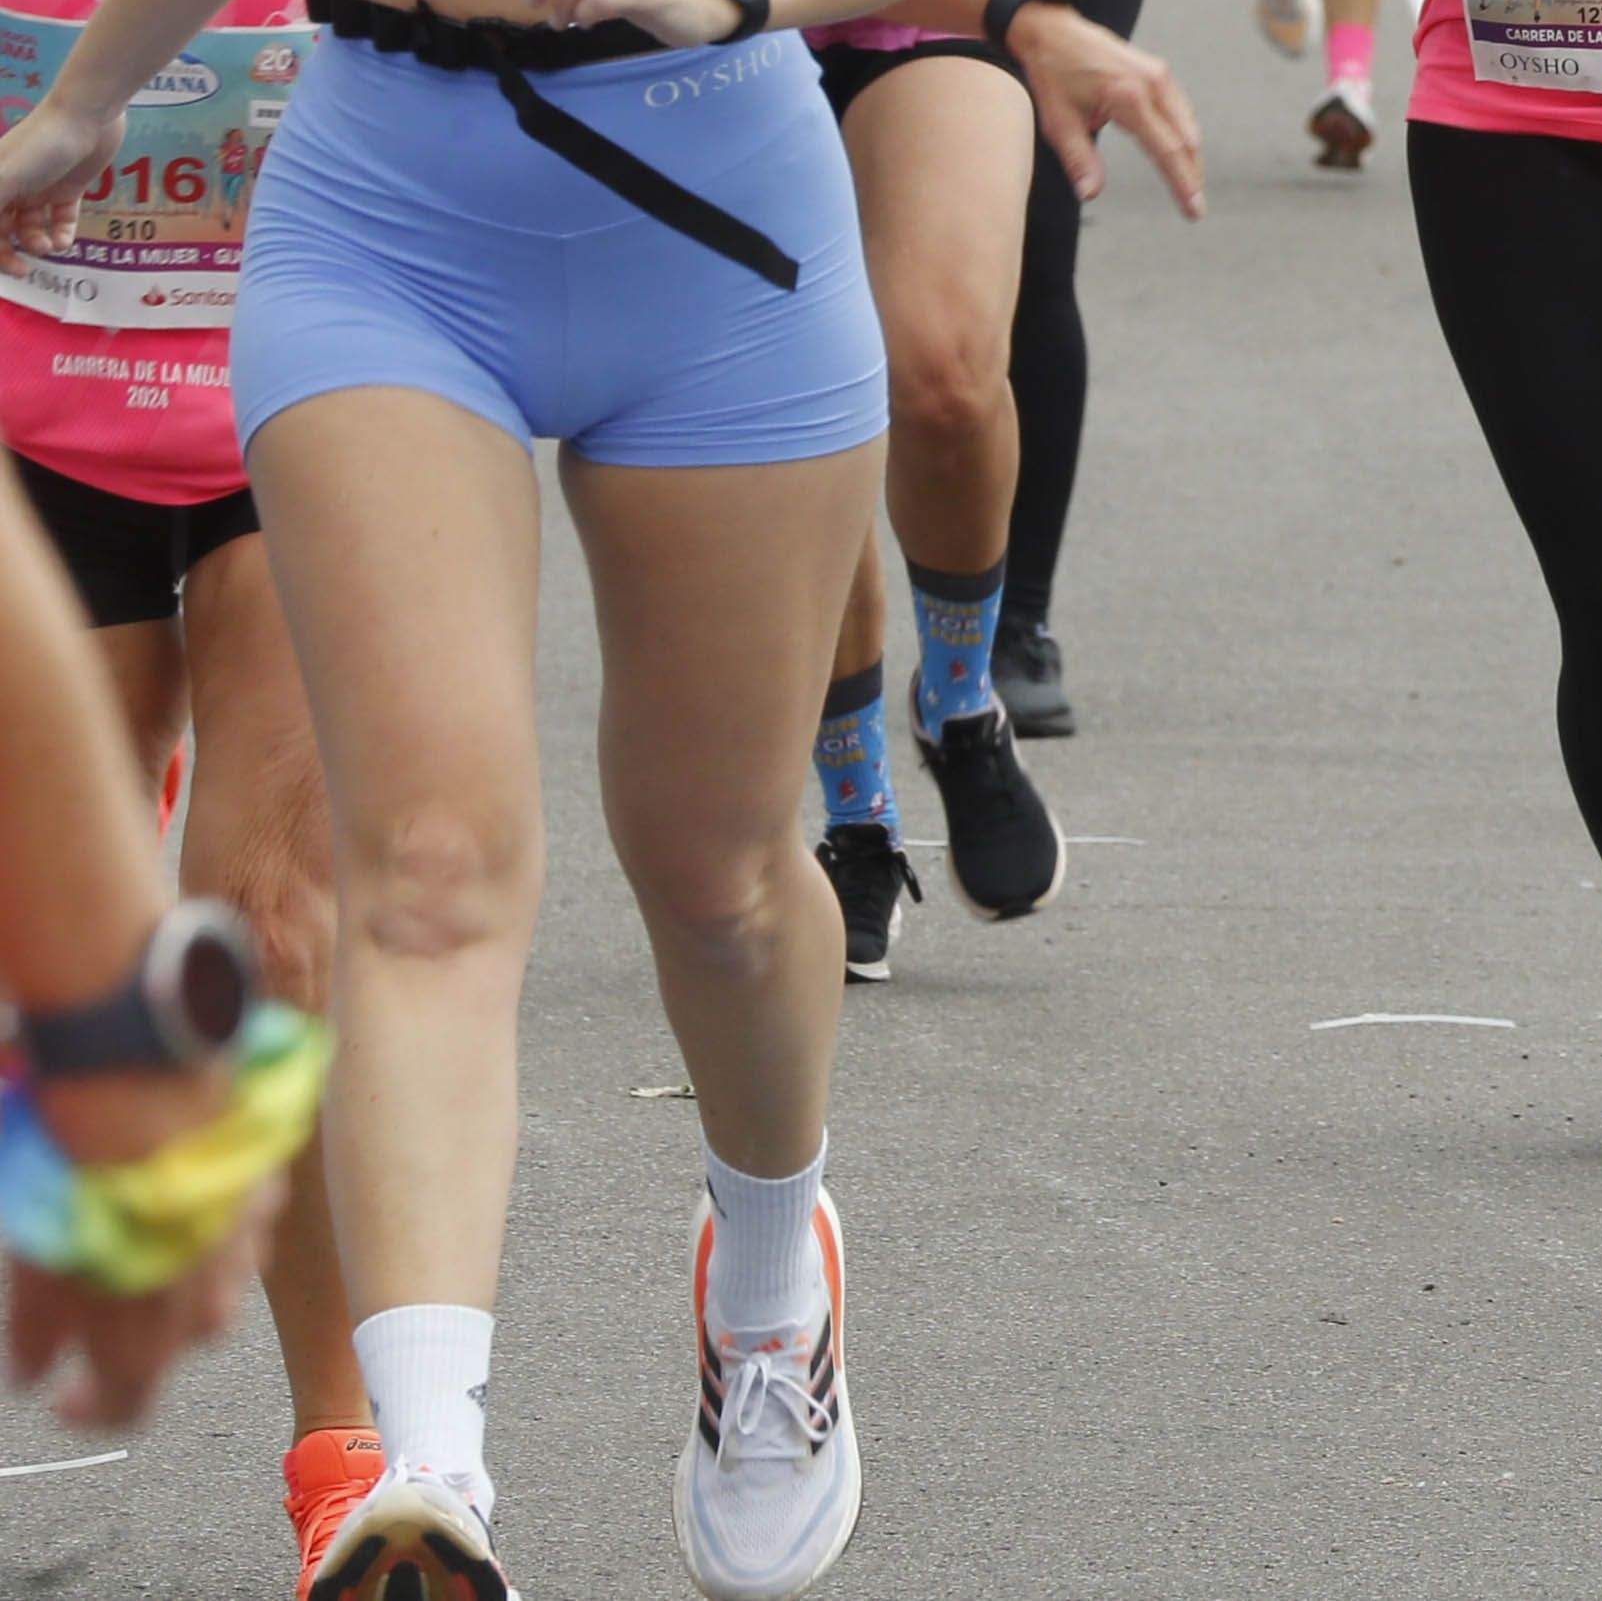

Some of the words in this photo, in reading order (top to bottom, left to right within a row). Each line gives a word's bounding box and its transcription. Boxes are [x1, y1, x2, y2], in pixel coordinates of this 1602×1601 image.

[1505, 27, 1564, 43] CARRERA
[1568, 29, 1585, 43] DE
[643, 38, 784, 109] OYSHO
[1500, 52, 1580, 76] OYSHO
[108, 218, 156, 240] 810
[52, 353, 130, 382] CARRERA
[134, 359, 156, 383] DE
[160, 361, 182, 384] LA
[126, 385, 170, 411] 2024
